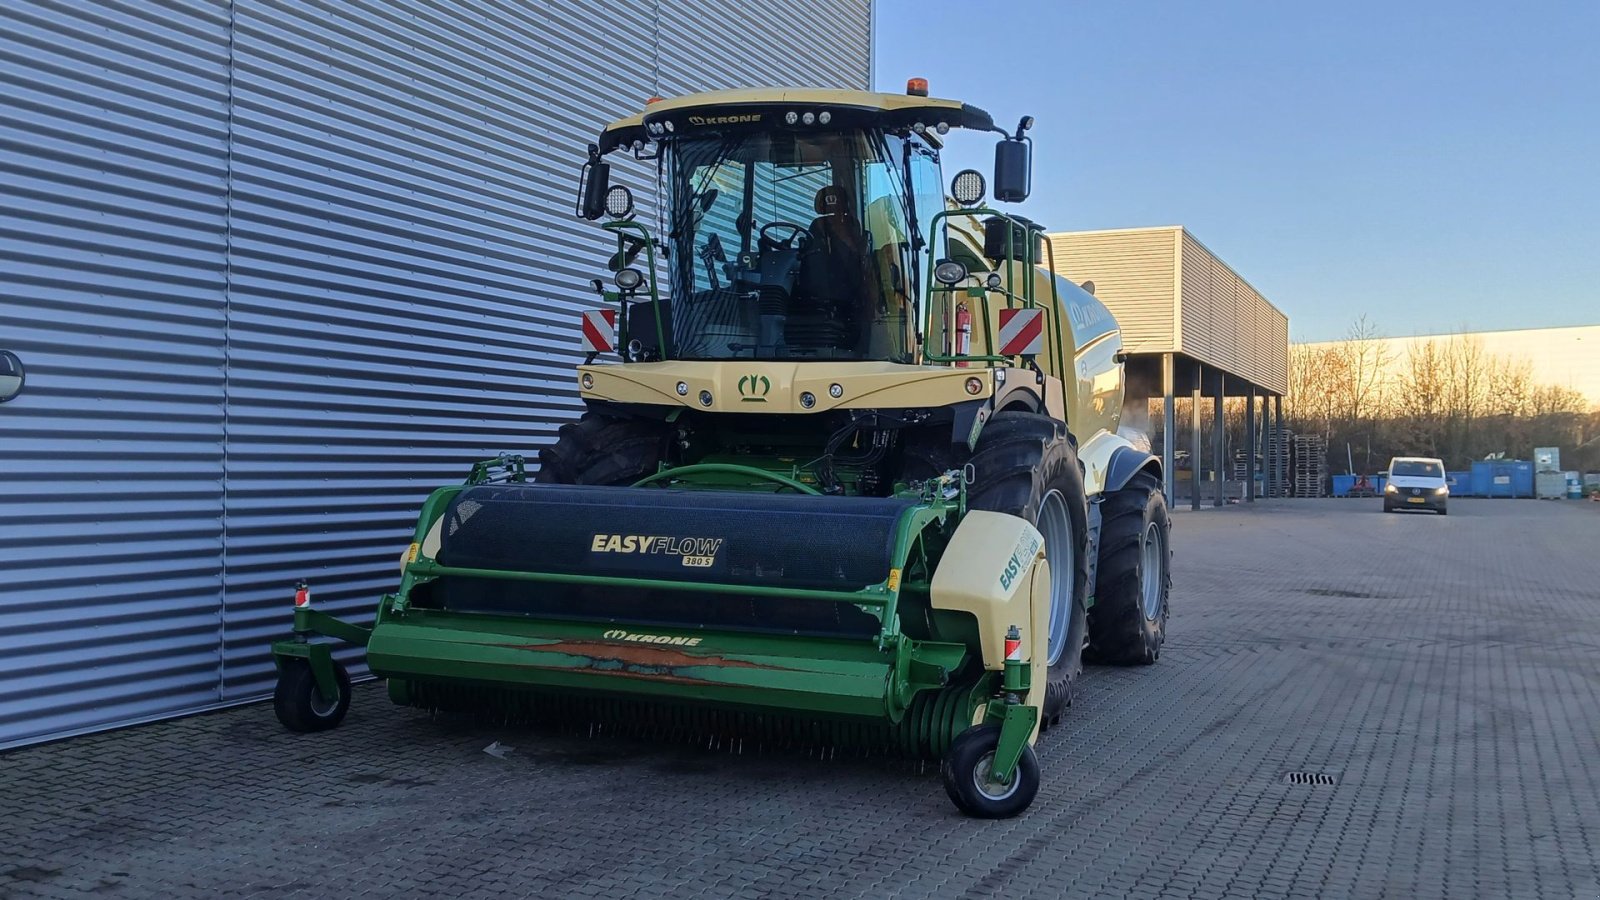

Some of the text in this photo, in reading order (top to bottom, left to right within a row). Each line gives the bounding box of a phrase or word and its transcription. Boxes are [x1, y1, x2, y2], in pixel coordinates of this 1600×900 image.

[706, 114, 761, 125] KRONE
[591, 534, 723, 557] EASYFLOW
[685, 557, 703, 566] 380
[624, 633, 703, 647] KRONE
